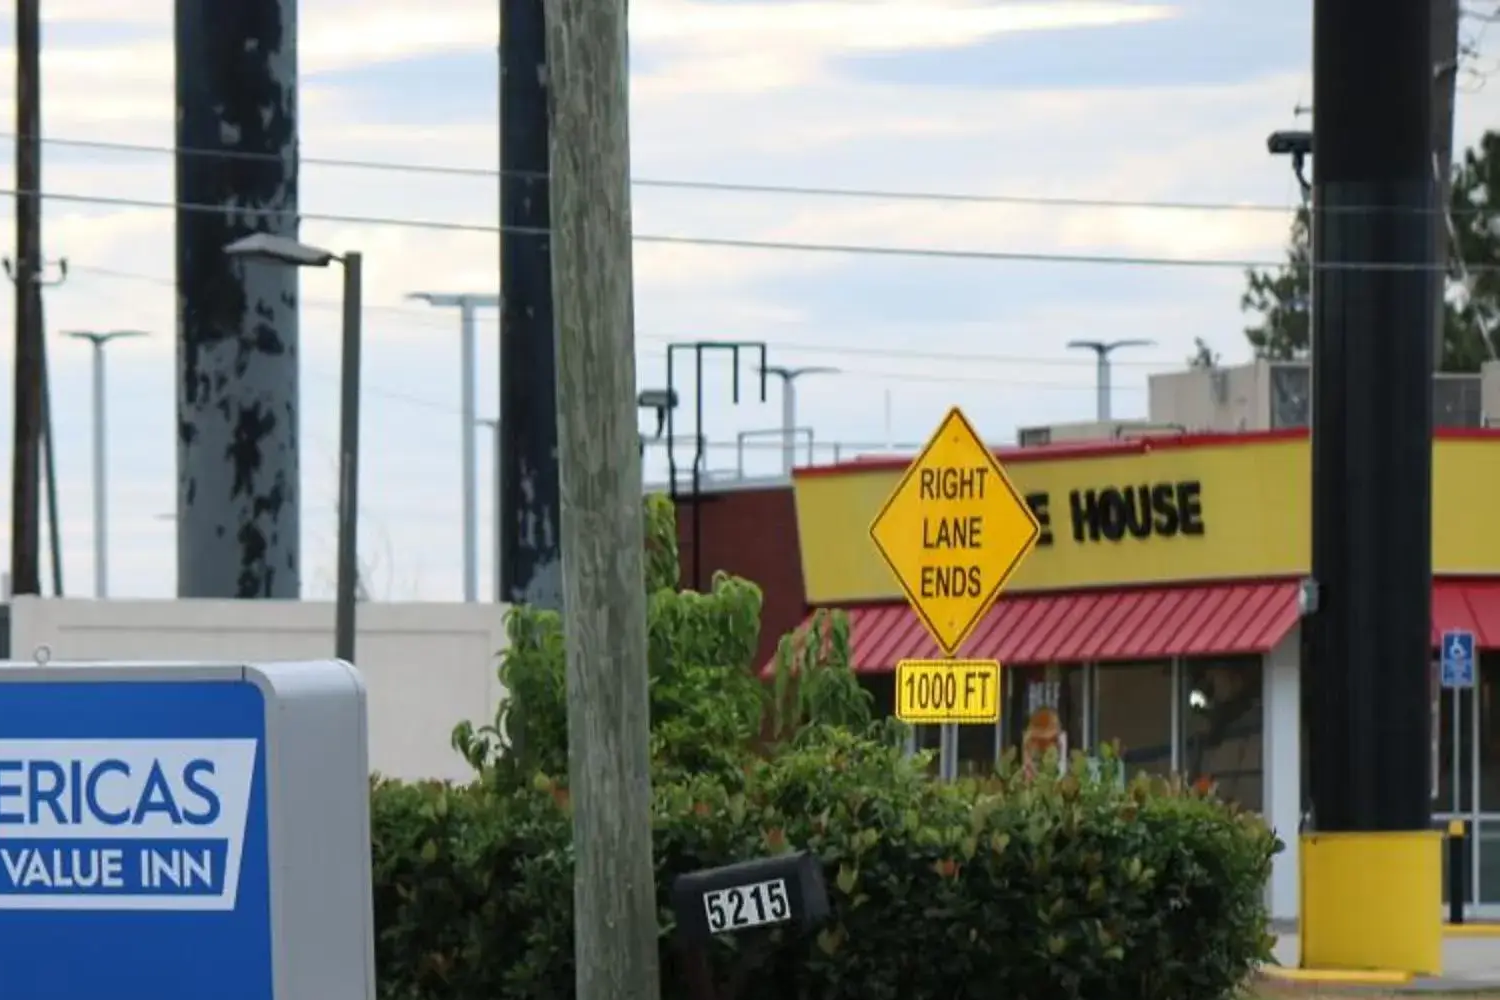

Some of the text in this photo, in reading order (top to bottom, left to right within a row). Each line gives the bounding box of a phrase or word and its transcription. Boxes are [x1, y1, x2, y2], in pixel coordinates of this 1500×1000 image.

[919, 467, 988, 499] RIGHT
[1069, 481, 1205, 543] HOUSE
[922, 517, 982, 549] LANE
[920, 567, 982, 598] ENDS
[905, 672, 957, 709] 1000
[964, 672, 991, 708] FT
[0, 849, 124, 887] VALUE
[140, 849, 213, 888] INN
[707, 883, 787, 929] 5215
